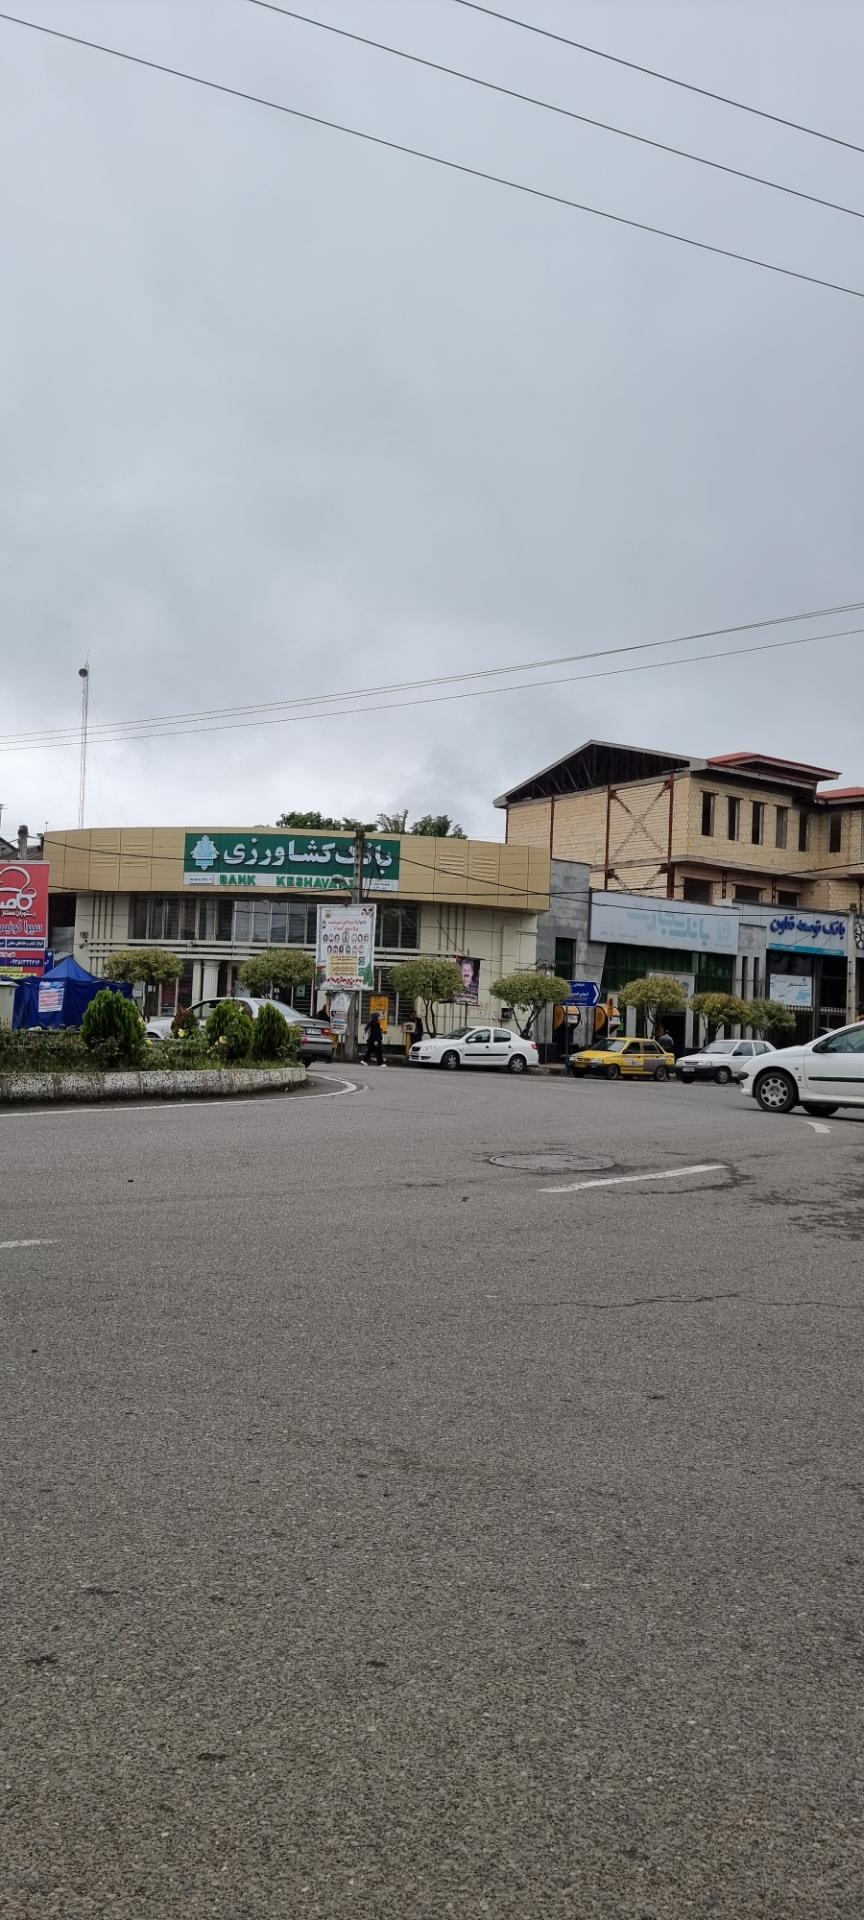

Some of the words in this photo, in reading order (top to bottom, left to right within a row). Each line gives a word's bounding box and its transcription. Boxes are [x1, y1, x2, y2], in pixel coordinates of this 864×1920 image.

[223, 837, 336, 866] کشاورزی
[335, 842, 393, 875] بانک
[219, 874, 256, 886] BANK
[626, 901, 686, 937] تجارت
[669, 916, 710, 947] بانک
[770, 915, 796, 935] تعاون
[796, 919, 822, 938] توسعه
[822, 919, 846, 940] بانک
